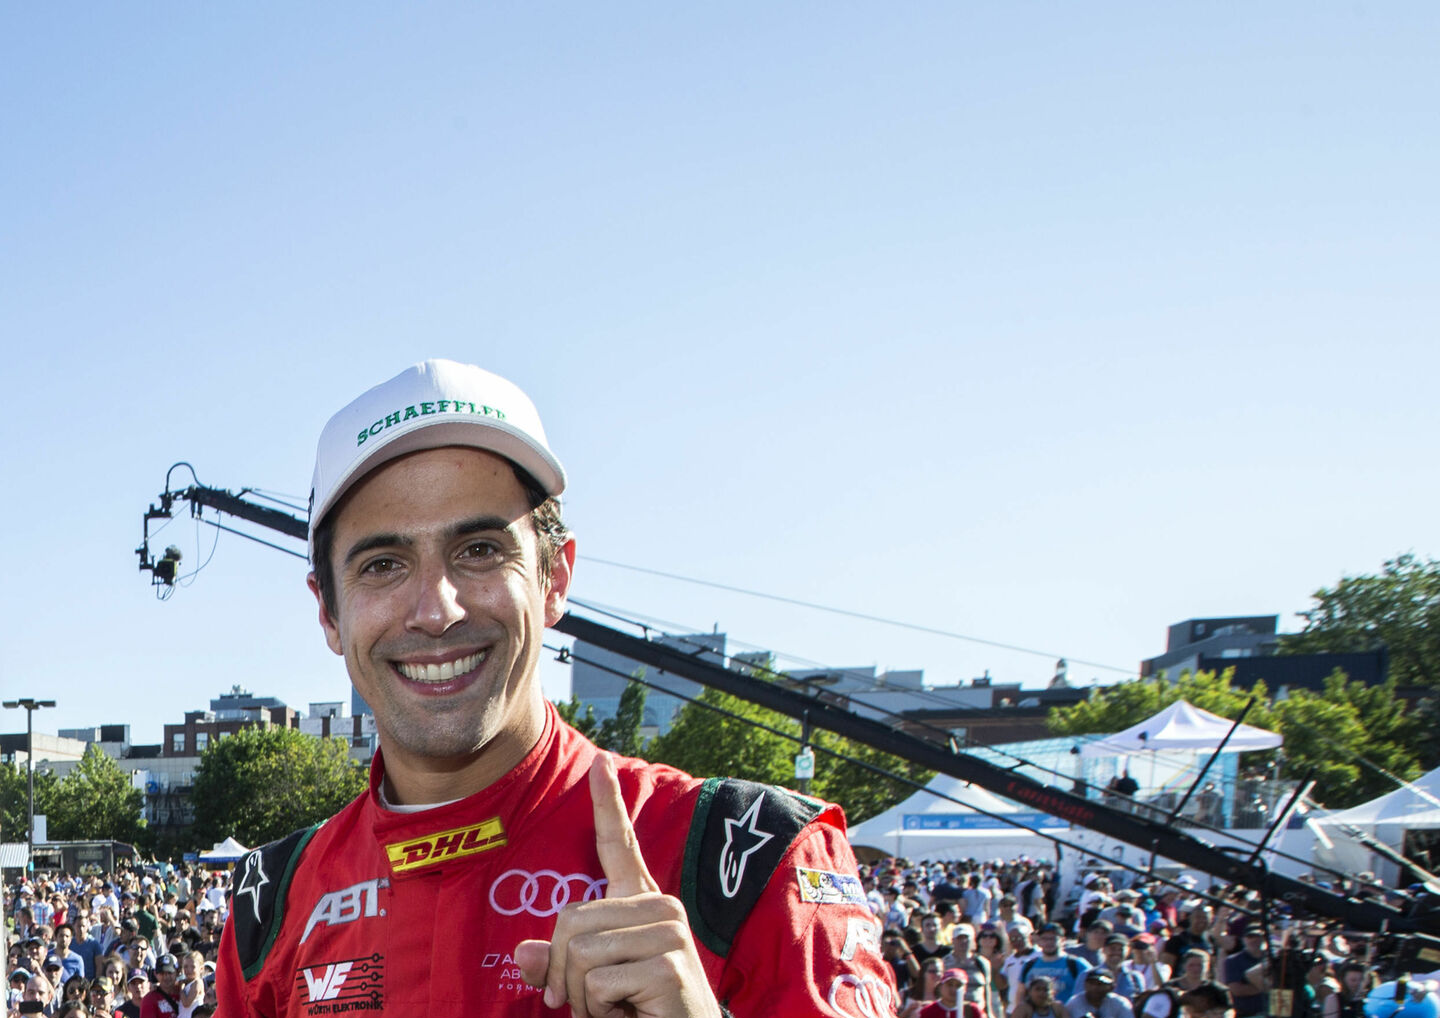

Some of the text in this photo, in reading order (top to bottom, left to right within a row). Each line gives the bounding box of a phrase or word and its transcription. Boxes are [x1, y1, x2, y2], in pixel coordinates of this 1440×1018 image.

[356, 399, 507, 447] SCHAEFFLER
[403, 828, 489, 866] DHL
[298, 877, 380, 946] ABT
[840, 917, 883, 962] AB
[303, 961, 354, 1002] WE
[332, 999, 384, 1014] ELEKTRONIK
